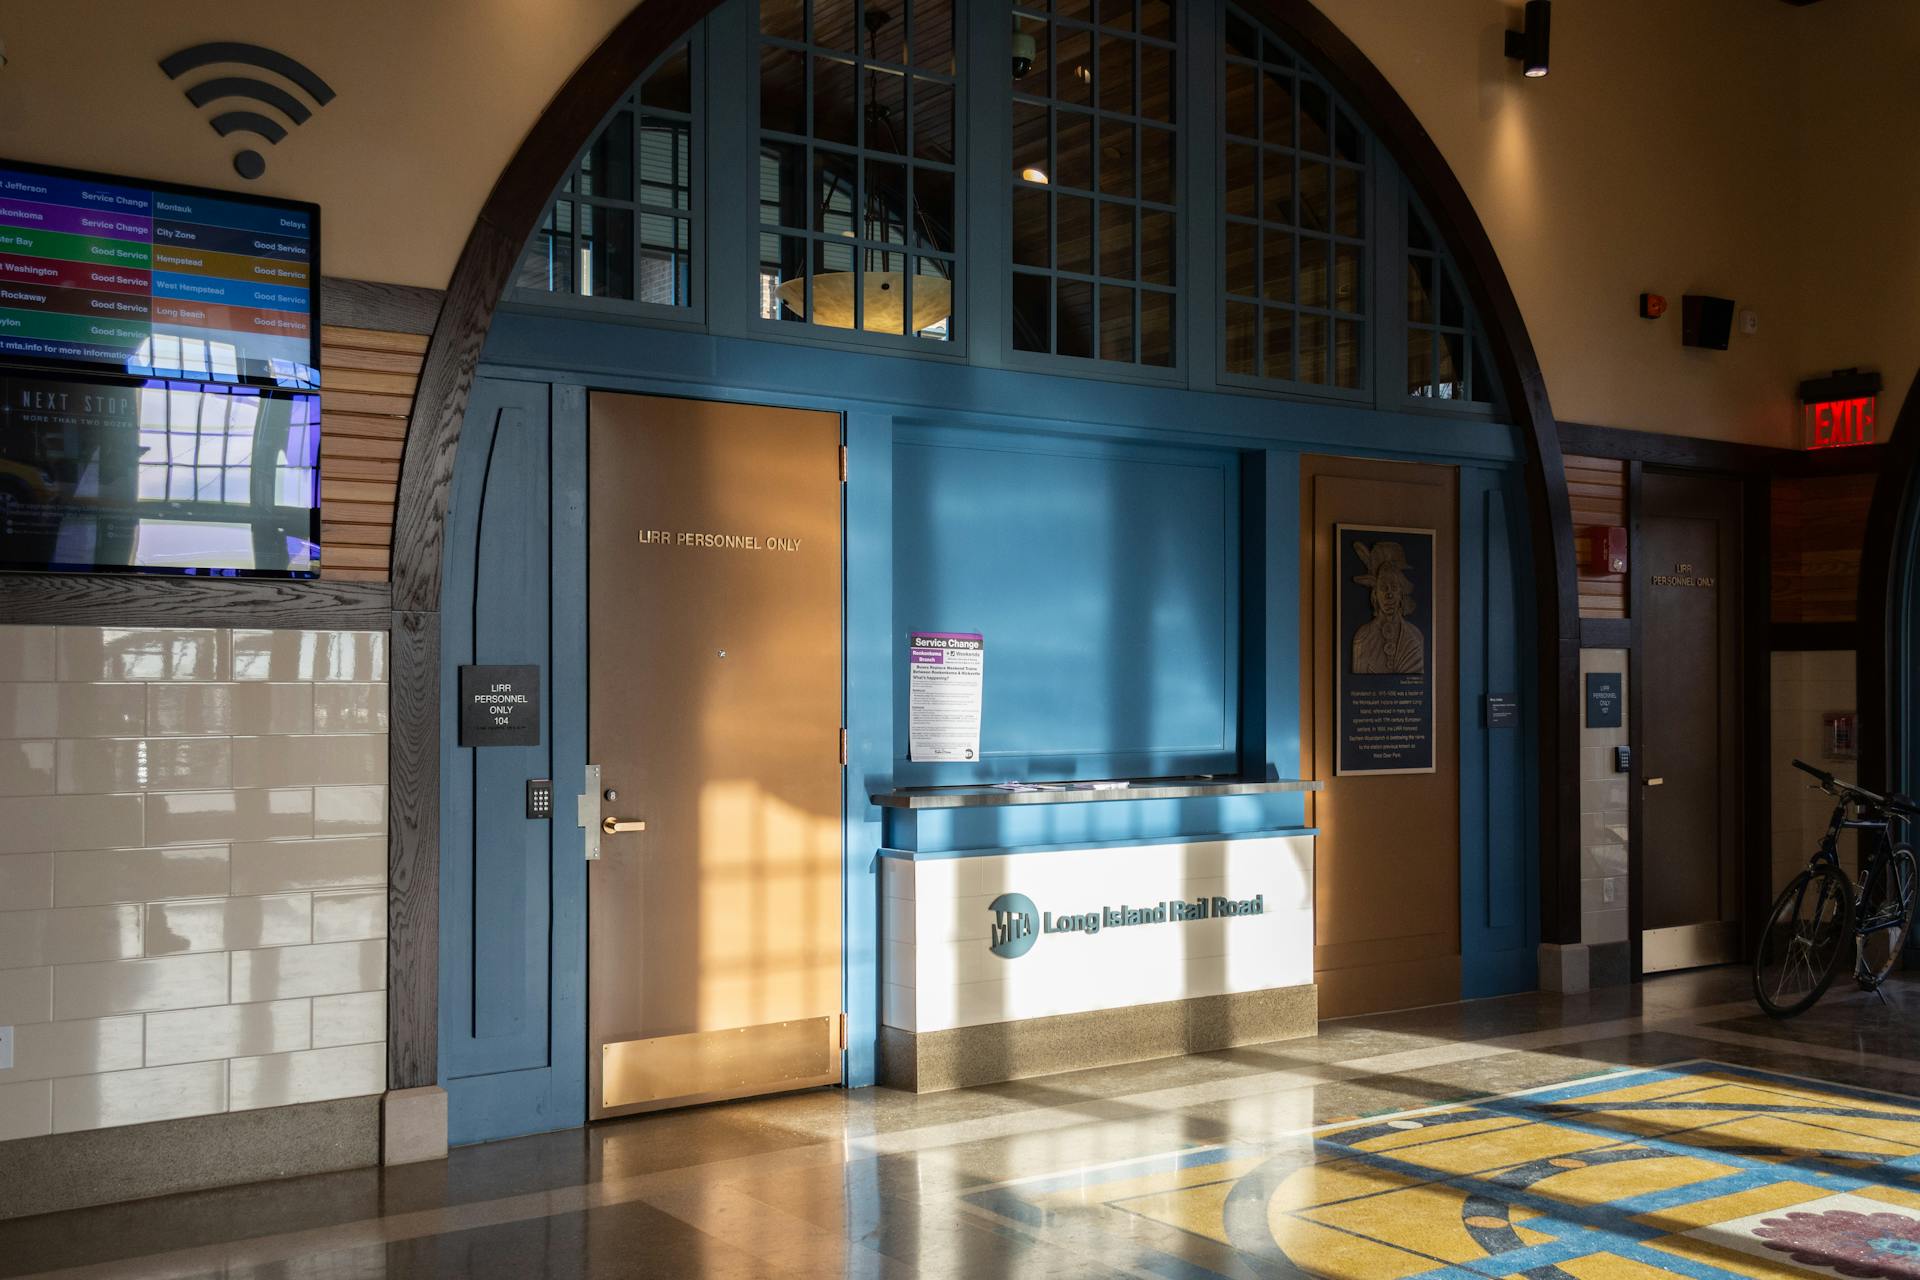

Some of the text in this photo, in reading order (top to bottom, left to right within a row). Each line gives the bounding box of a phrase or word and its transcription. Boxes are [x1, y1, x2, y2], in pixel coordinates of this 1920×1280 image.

[5, 182, 47, 193] Jefferson
[82, 192, 148, 208] Service Change
[157, 202, 192, 214] Montauk
[81, 218, 148, 234] Service Change
[280, 219, 306, 230] Delays
[157, 228, 196, 240] City Zone
[16, 237, 33, 248] Bay
[254, 240, 306, 254] Good Service
[91, 246, 148, 260] Good Service
[157, 254, 203, 266] Hempstead
[6, 264, 58, 276] Washington
[254, 266, 306, 279] Good Service
[91, 273, 148, 286] Good Service
[157, 280, 224, 295] West Hempstead
[1, 290, 46, 303] Rockaway
[254, 292, 306, 304] Good Service
[91, 300, 148, 312] Good Service
[157, 308, 206, 319] Long Beach
[254, 318, 306, 330] Good Service
[91, 326, 148, 338] Good Service
[6, 342, 42, 352] mta.info
[44, 344, 58, 353] for
[60, 347, 82, 355] more
[24, 390, 68, 410] NEXT
[24, 415, 48, 423] MORE
[54, 416, 77, 425] THAN
[1816, 397, 1868, 445] EXIT
[639, 530, 802, 552] LIRR PERSONNEL ONLY
[1676, 564, 1692, 574] LIRR
[1653, 575, 1714, 587] PERSONNEL ONLY
[916, 638, 979, 650] Service Change
[491, 684, 512, 692] LIRR
[474, 694, 528, 703] PERSONNEL
[490, 706, 514, 714] ONLY
[494, 717, 509, 725] 104
[1043, 894, 1264, 935] Long Island Rail Road
[991, 910, 1032, 949] MTA
